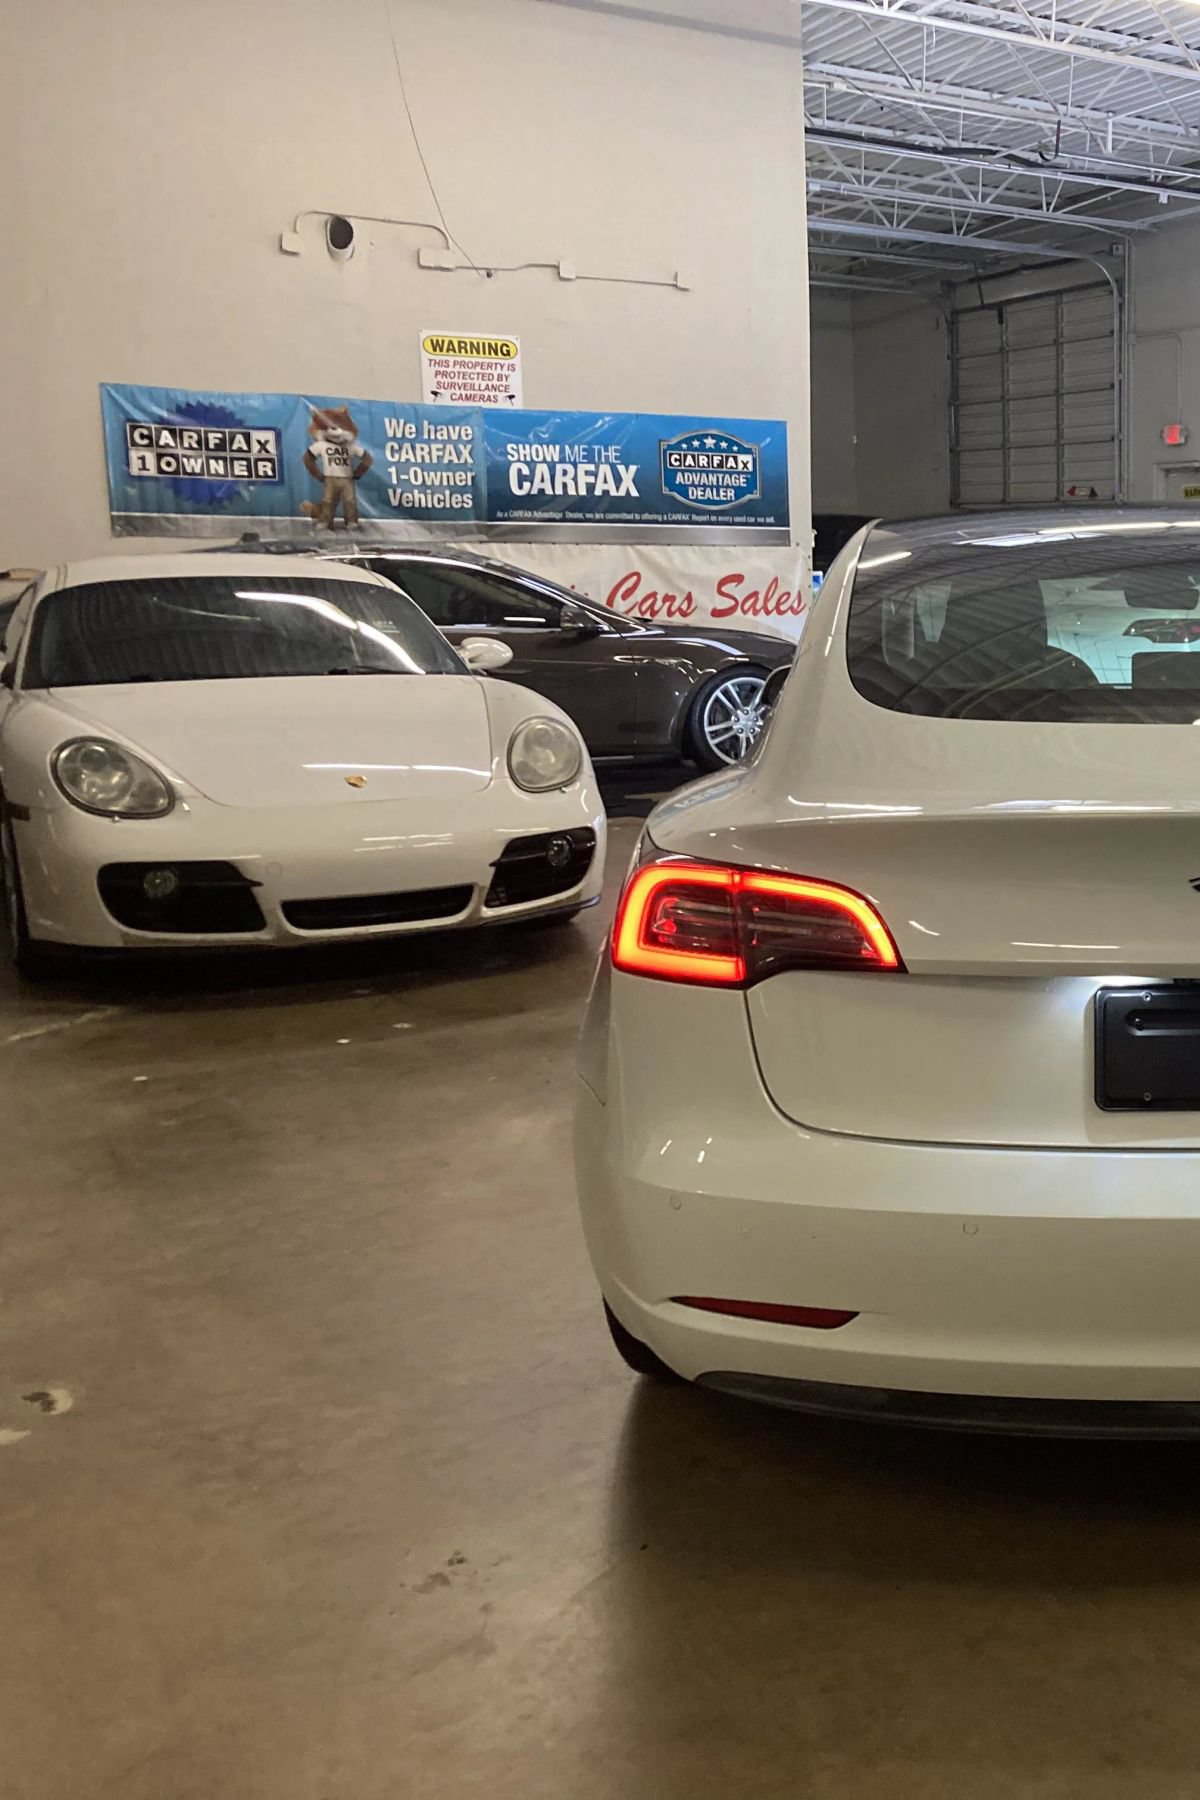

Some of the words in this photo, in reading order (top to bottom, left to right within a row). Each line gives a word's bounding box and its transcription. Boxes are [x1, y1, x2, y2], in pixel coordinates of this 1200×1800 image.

[429, 338, 511, 357] WARNING
[428, 358, 450, 368] THIS
[452, 360, 505, 371] PROPERTY
[507, 363, 516, 372] IS
[434, 370, 494, 381] PROTECTED
[497, 373, 510, 382] BY
[435, 381, 510, 393] SURVEILLANCE
[450, 393, 499, 403] CAMERAS
[384, 417, 417, 439] We
[423, 419, 473, 441] have
[133, 427, 272, 454] CARFAX
[326, 447, 349, 457] CAR
[384, 441, 474, 464] CARFAX
[506, 443, 560, 462] SHOW
[564, 444, 588, 463] ME
[592, 445, 621, 463] THE
[137, 455, 151, 471] 1
[160, 456, 273, 477] OWNER
[328, 457, 349, 467] FOX
[670, 454, 750, 471] CARFAX
[387, 465, 475, 487] 1-Owner
[508, 461, 640, 497] CARFAX
[675, 471, 748, 487] ADVANTAGE
[387, 488, 473, 509] Vehicles
[688, 486, 736, 501] DEALER
[606, 571, 699, 618] Cars
[710, 573, 807, 619] Sales
